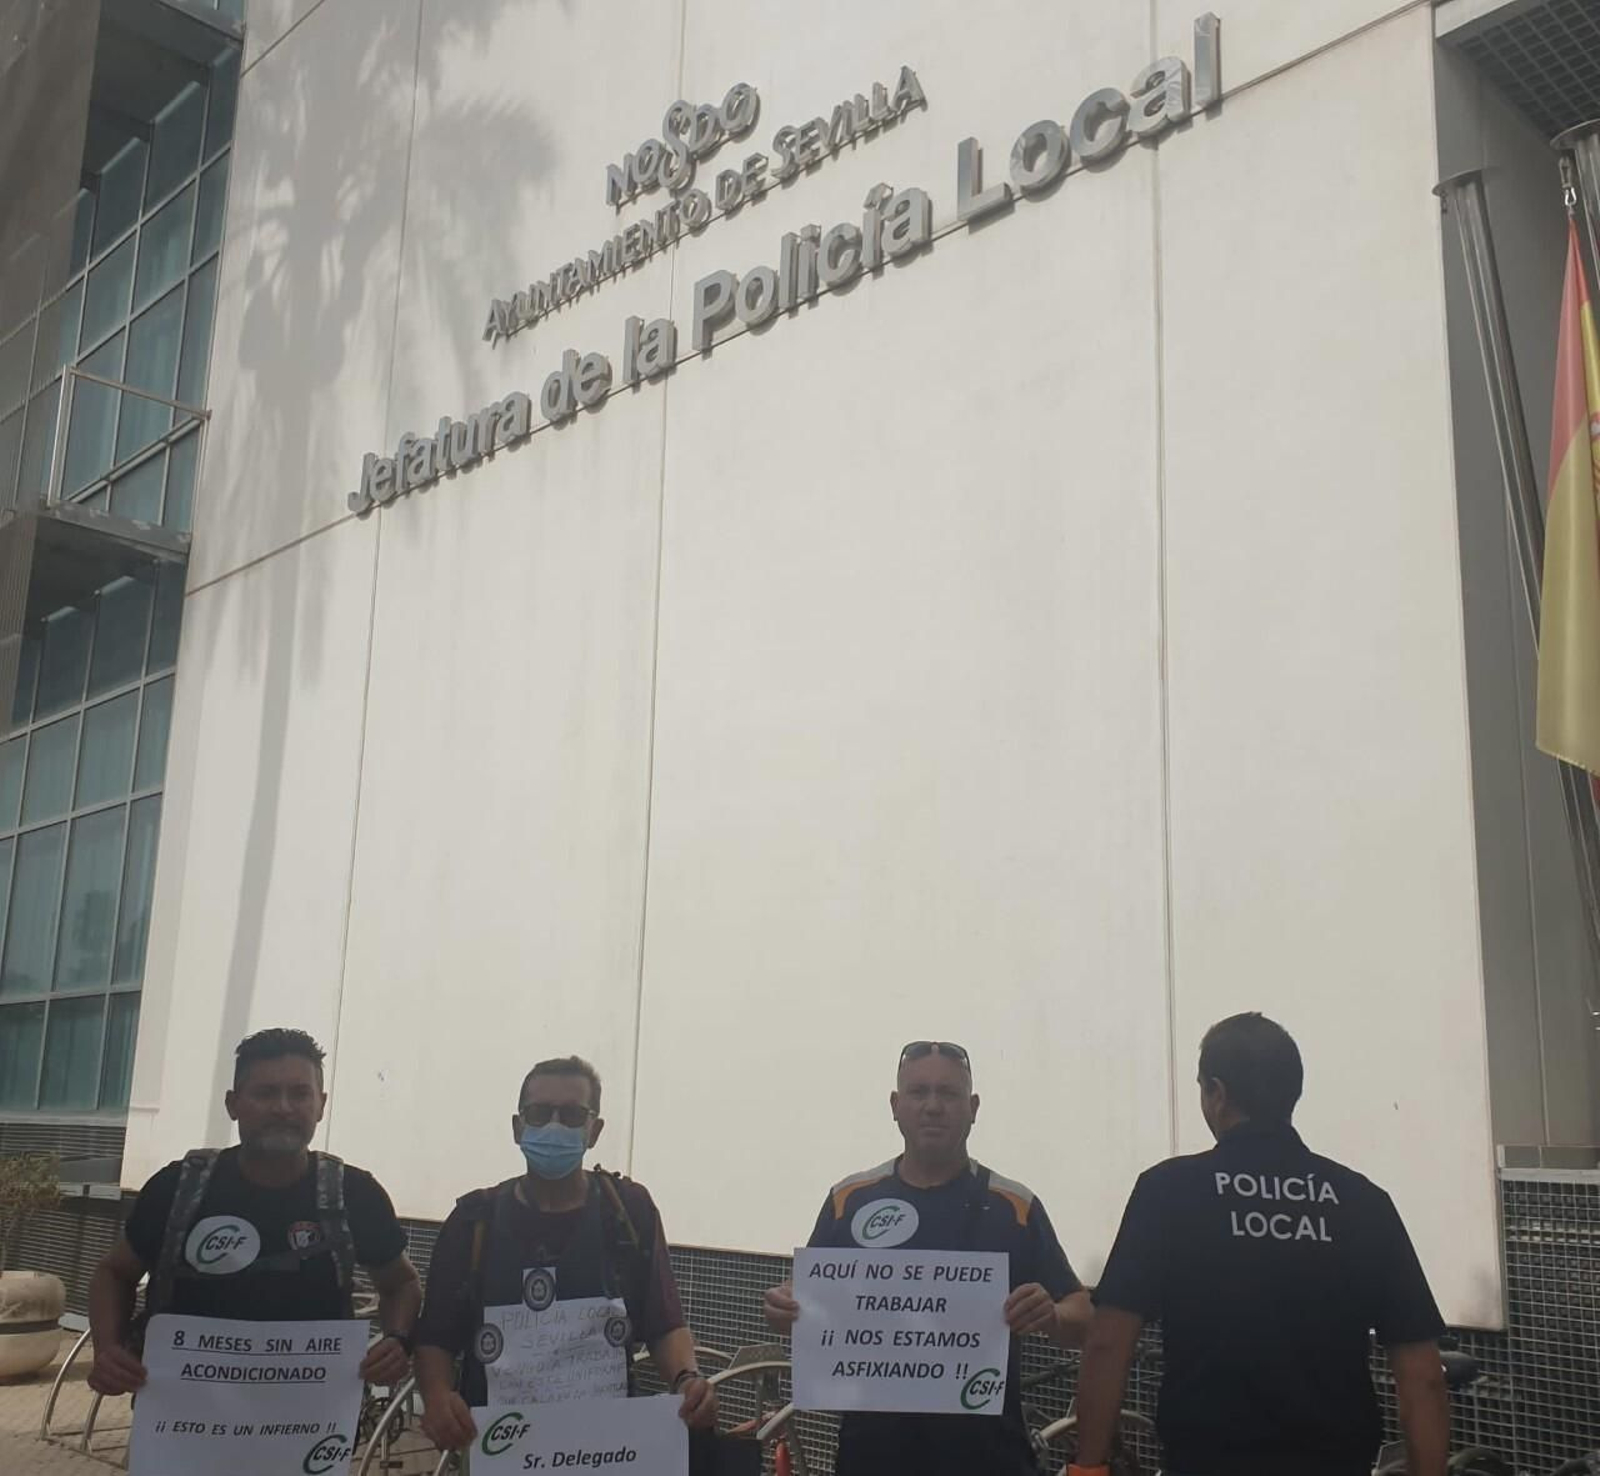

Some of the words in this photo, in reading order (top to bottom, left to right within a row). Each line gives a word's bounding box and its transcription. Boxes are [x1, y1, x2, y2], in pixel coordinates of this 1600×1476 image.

[482, 188, 711, 344] AYUNTAMIENTO
[715, 153, 768, 210] DE
[773, 65, 928, 178] SEVILLA
[348, 391, 531, 513] Jefatura
[541, 349, 612, 421] de
[623, 315, 677, 383] la
[692, 183, 932, 352] Policía
[957, 12, 1221, 220] Local
[1215, 1172, 1340, 1205] POLICÍA
[1230, 1211, 1333, 1242] LOCAL
[809, 1260, 859, 1280] AQUÍ
[865, 1263, 893, 1280] NO
[902, 1264, 924, 1281] SE
[933, 1266, 994, 1283] PUEDE
[855, 1295, 947, 1313] TRABAJAR
[173, 1330, 185, 1346] 8
[198, 1334, 252, 1352] MESES
[265, 1337, 293, 1353] SIN
[305, 1337, 342, 1353] AIRE
[845, 1329, 884, 1346] NOS
[893, 1330, 981, 1348] ESTAMOS
[180, 1362, 326, 1381] ACONDICIONADO
[832, 1361, 945, 1379] ASFIXIANDO
[173, 1421, 205, 1434] ESTO
[212, 1423, 227, 1436] ES
[233, 1424, 254, 1436] UN
[260, 1422, 320, 1435] INFIERNO
[523, 1452, 546, 1470] Sr.
[552, 1446, 637, 1469] Delegado
